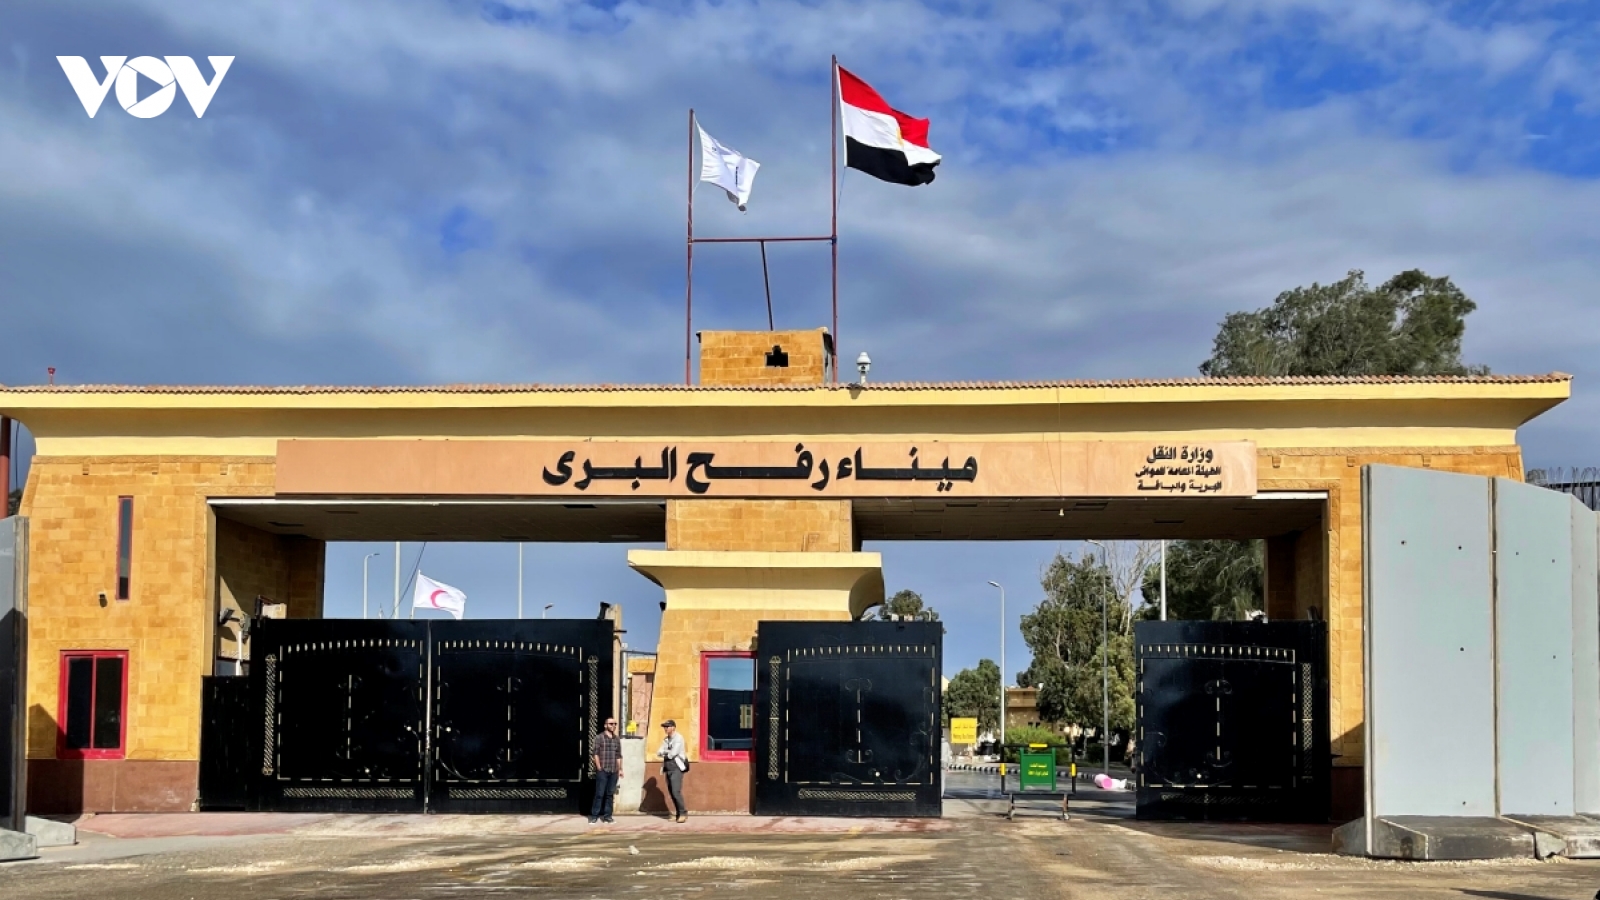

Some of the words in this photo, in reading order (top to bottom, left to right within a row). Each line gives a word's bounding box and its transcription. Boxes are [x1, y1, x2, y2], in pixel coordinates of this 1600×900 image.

[686, 443, 829, 494] رفح
[836, 447, 977, 492] ميناء
[1147, 445, 1177, 463] النقل
[1181, 445, 1214, 463] وزارة
